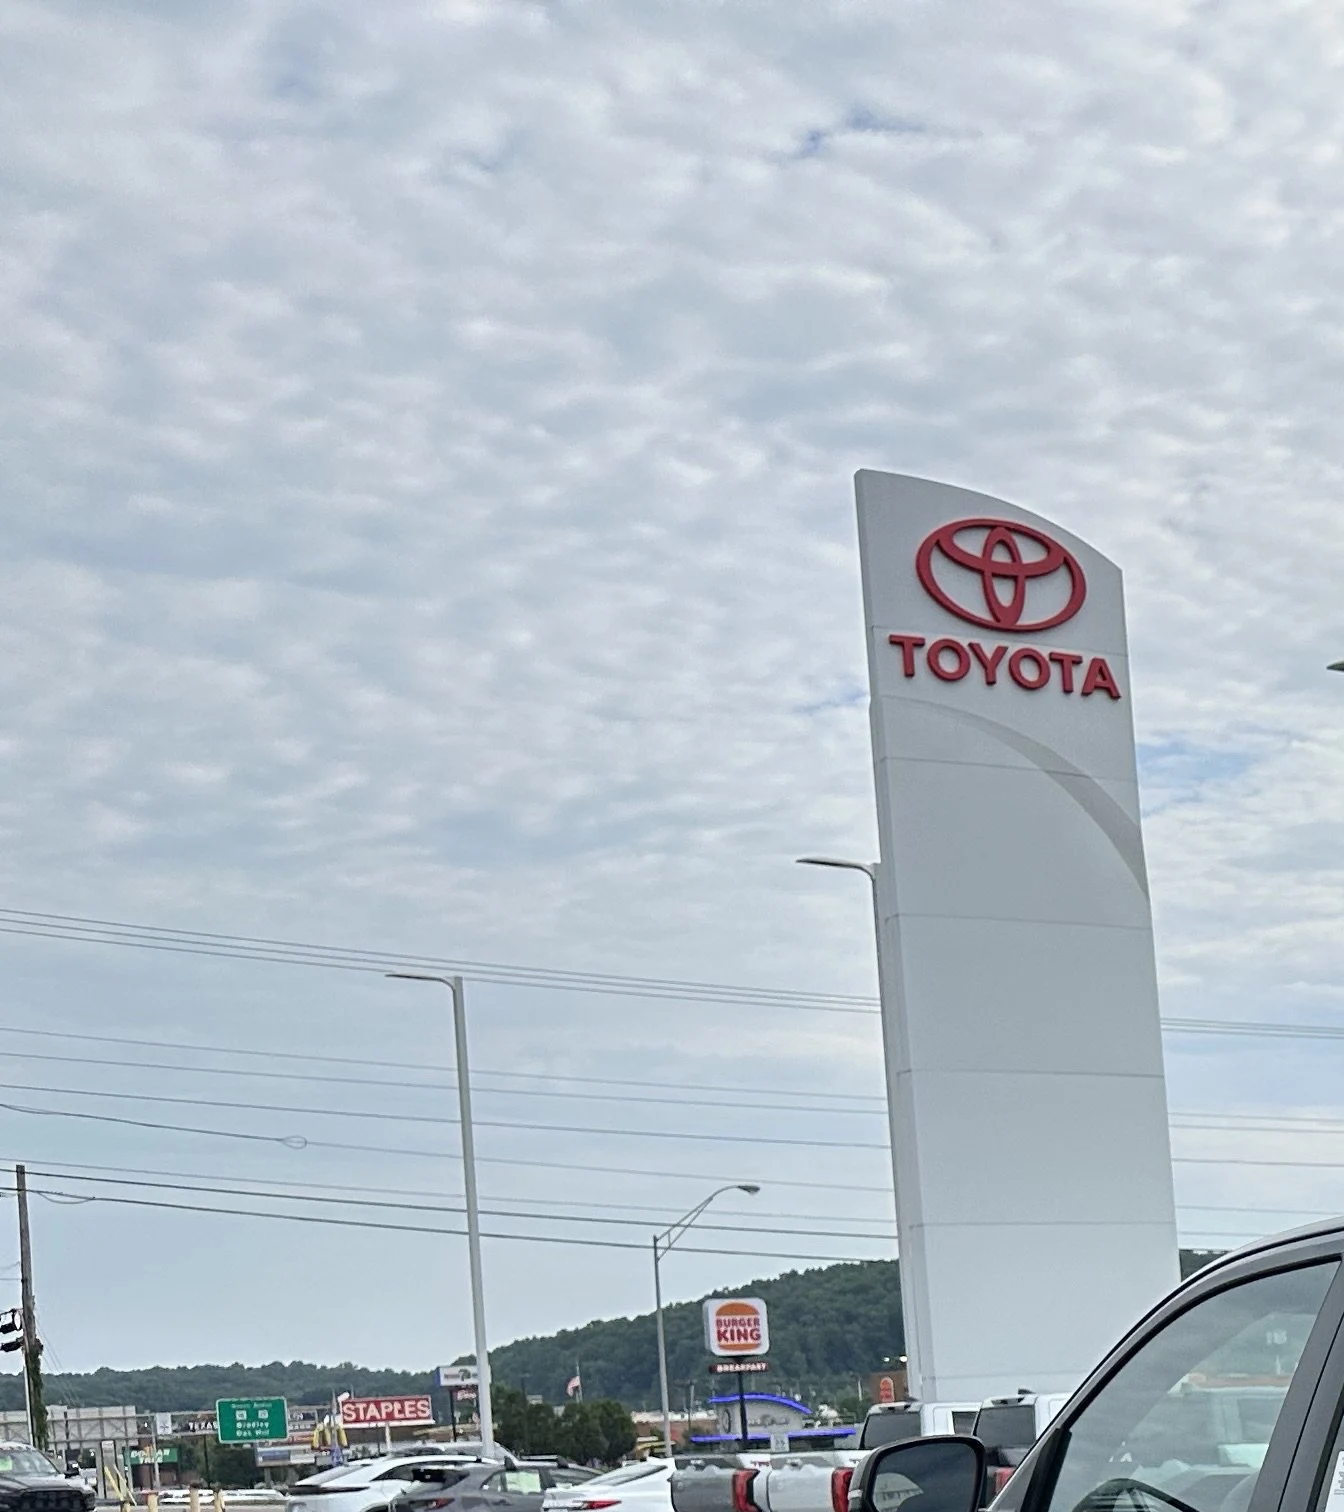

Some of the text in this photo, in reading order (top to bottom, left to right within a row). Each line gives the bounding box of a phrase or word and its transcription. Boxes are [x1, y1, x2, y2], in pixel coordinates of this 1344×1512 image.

[889, 634, 1122, 700] TOYOTA
[715, 1317, 761, 1328] BURGER
[717, 1328, 762, 1343] KING
[342, 1399, 431, 1422] STAPLES
